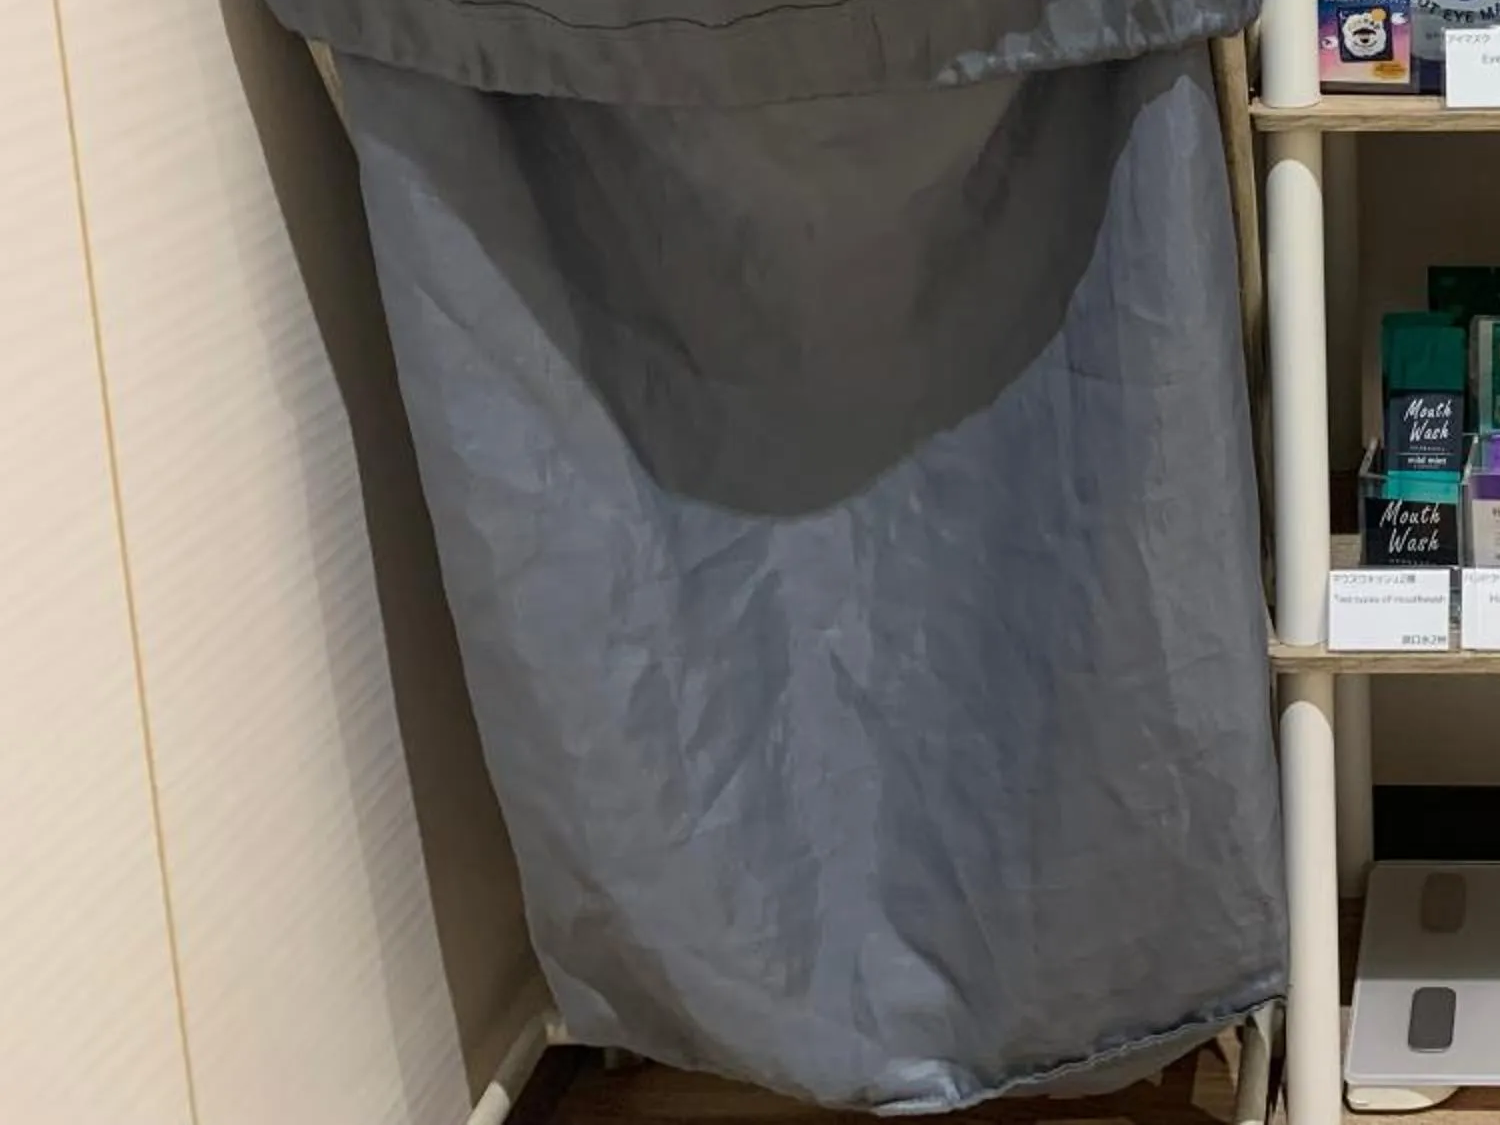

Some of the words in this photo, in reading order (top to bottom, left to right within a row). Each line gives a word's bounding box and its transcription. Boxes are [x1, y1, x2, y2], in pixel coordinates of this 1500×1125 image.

[1443, 10, 1475, 24] EYE
[1448, 34, 1491, 44] アイマスク
[1404, 398, 1453, 422] Mouth
[1409, 419, 1450, 443] Wash
[1380, 499, 1441, 527] Mouth
[1388, 527, 1441, 555] Wash
